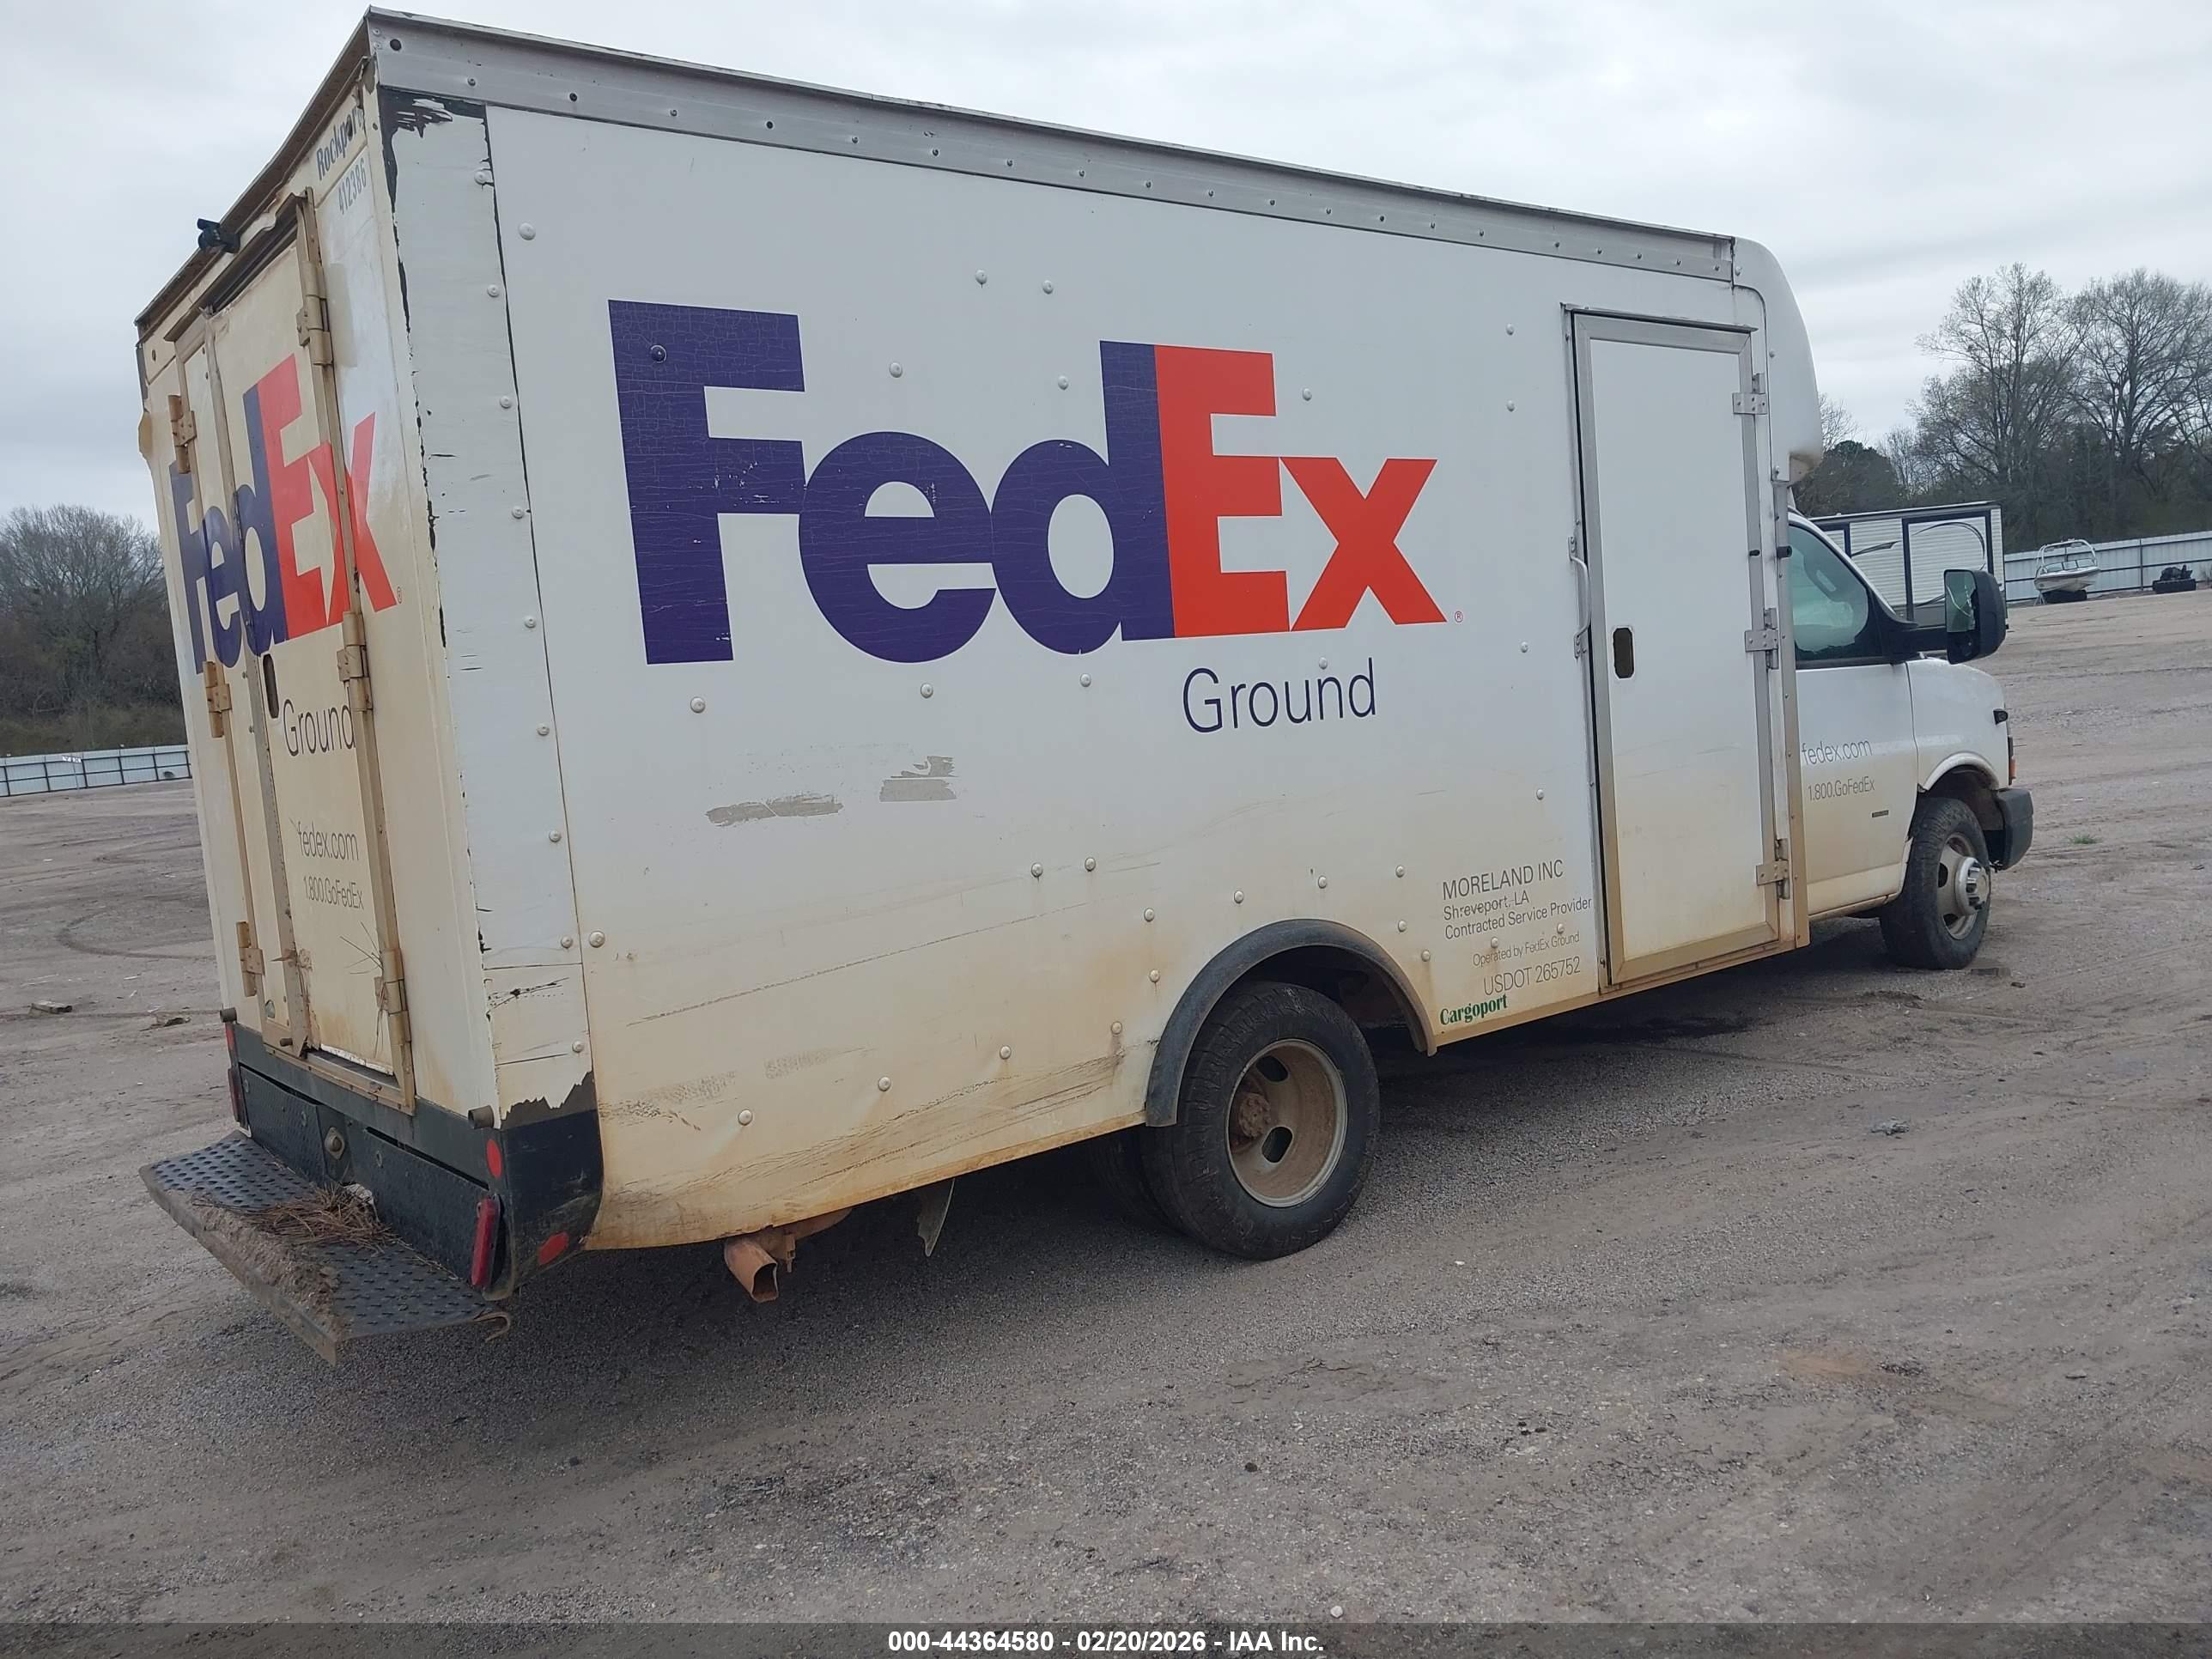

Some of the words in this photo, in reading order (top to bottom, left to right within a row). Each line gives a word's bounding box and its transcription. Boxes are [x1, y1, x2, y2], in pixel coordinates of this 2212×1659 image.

[607, 300, 1447, 664] FedEx
[169, 353, 398, 674] FedEx
[1182, 657, 1376, 733] Ground
[283, 687, 356, 757] Ground
[1802, 739, 1873, 765] fedex.com
[1808, 775, 1875, 801] 1.800.GoFedEx
[297, 821, 359, 860] fedex.com
[303, 876, 364, 909] 1.800.GoFedEx
[1443, 865, 1534, 900] MORELAND
[1538, 859, 1564, 881] INC
[1514, 890, 1529, 905] LA
[1445, 914, 1505, 939] Contracted
[1508, 907, 1547, 926] Service
[1551, 897, 1592, 917] Provider
[1473, 947, 1511, 968] Operated
[1513, 943, 1523, 958] by
[1525, 939, 1549, 955] FedEx
[1551, 932, 1580, 947] Ground
[1484, 967, 1532, 996] USDOT
[1535, 956, 1581, 984] 265752
[1440, 994, 1508, 1025] Cargoport
